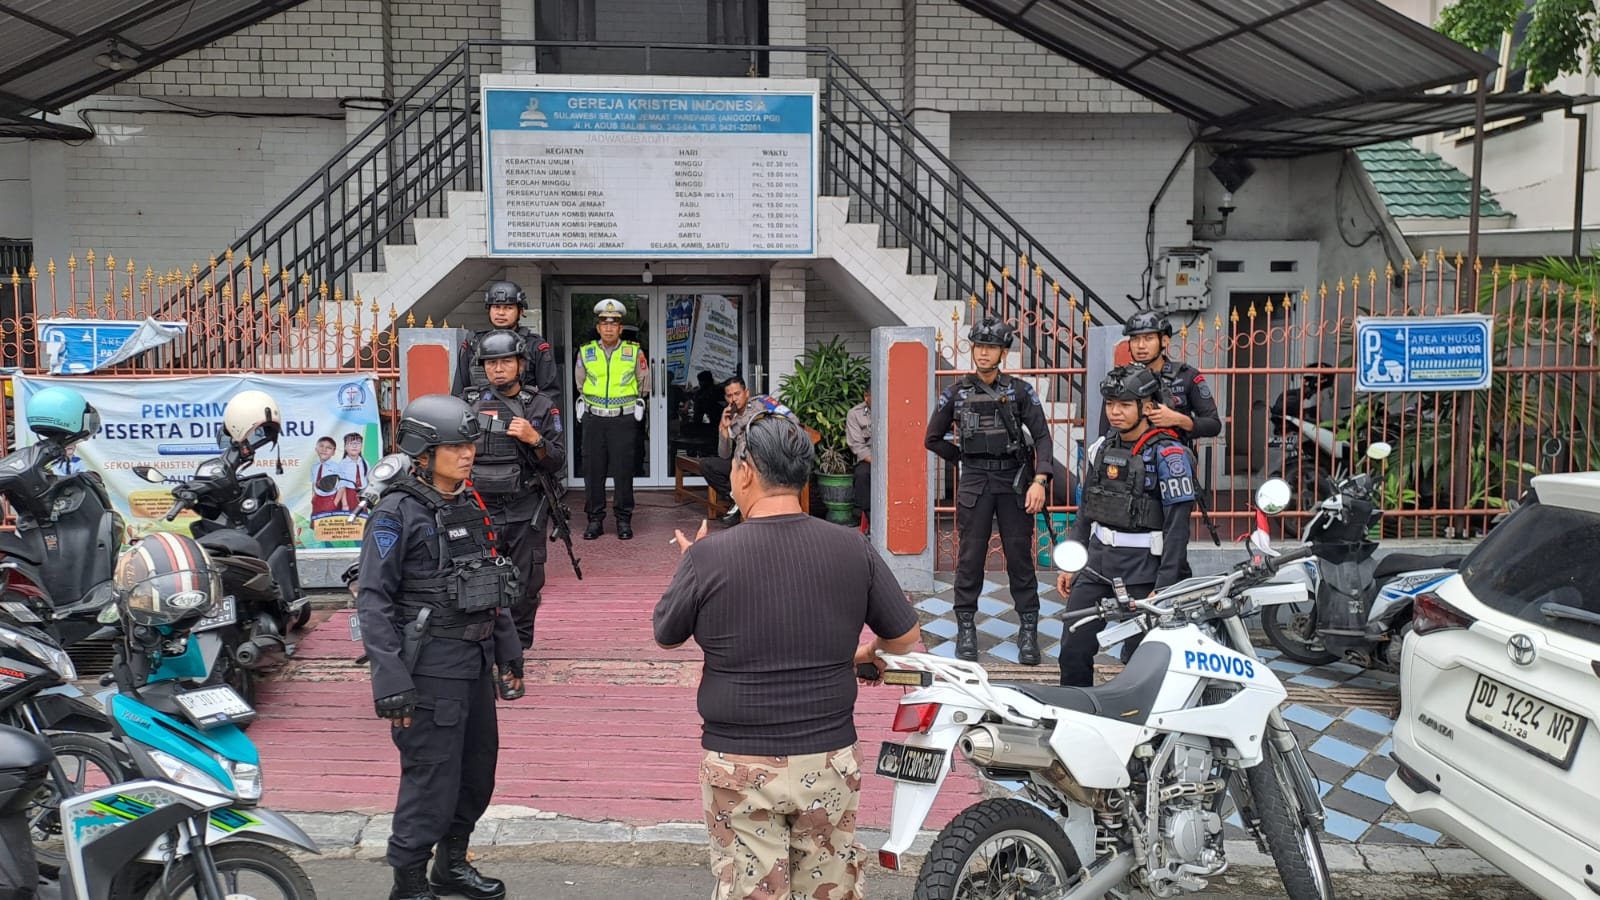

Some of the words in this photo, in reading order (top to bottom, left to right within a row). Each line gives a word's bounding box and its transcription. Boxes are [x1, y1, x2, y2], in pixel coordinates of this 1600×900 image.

[567, 97, 625, 109] GEREJA
[628, 98, 688, 111] KRISTEN
[692, 99, 767, 112] INDONESIA
[553, 111, 597, 120] SULAWESI
[598, 112, 636, 121] SELATAN
[639, 112, 670, 121] JEMAAT
[673, 113, 716, 122] PAREPARE
[718, 114, 761, 122] (ANGGOTA
[763, 114, 781, 123] PGI)
[1365, 330, 1382, 365] P
[1411, 334, 1438, 345] AREA
[1441, 333, 1481, 344] KHUSUS
[1411, 345, 1446, 356] PARKIR
[1447, 344, 1481, 355] MOTOR
[154, 461, 196, 470] KRISTEN
[1184, 649, 1255, 679] PROVOS
[121, 709, 151, 729] YAMAHA
[1477, 680, 1499, 708] DD
[1501, 691, 1545, 730] 1424
[1547, 711, 1575, 744] NR
[1418, 713, 1454, 740] AVANZA
